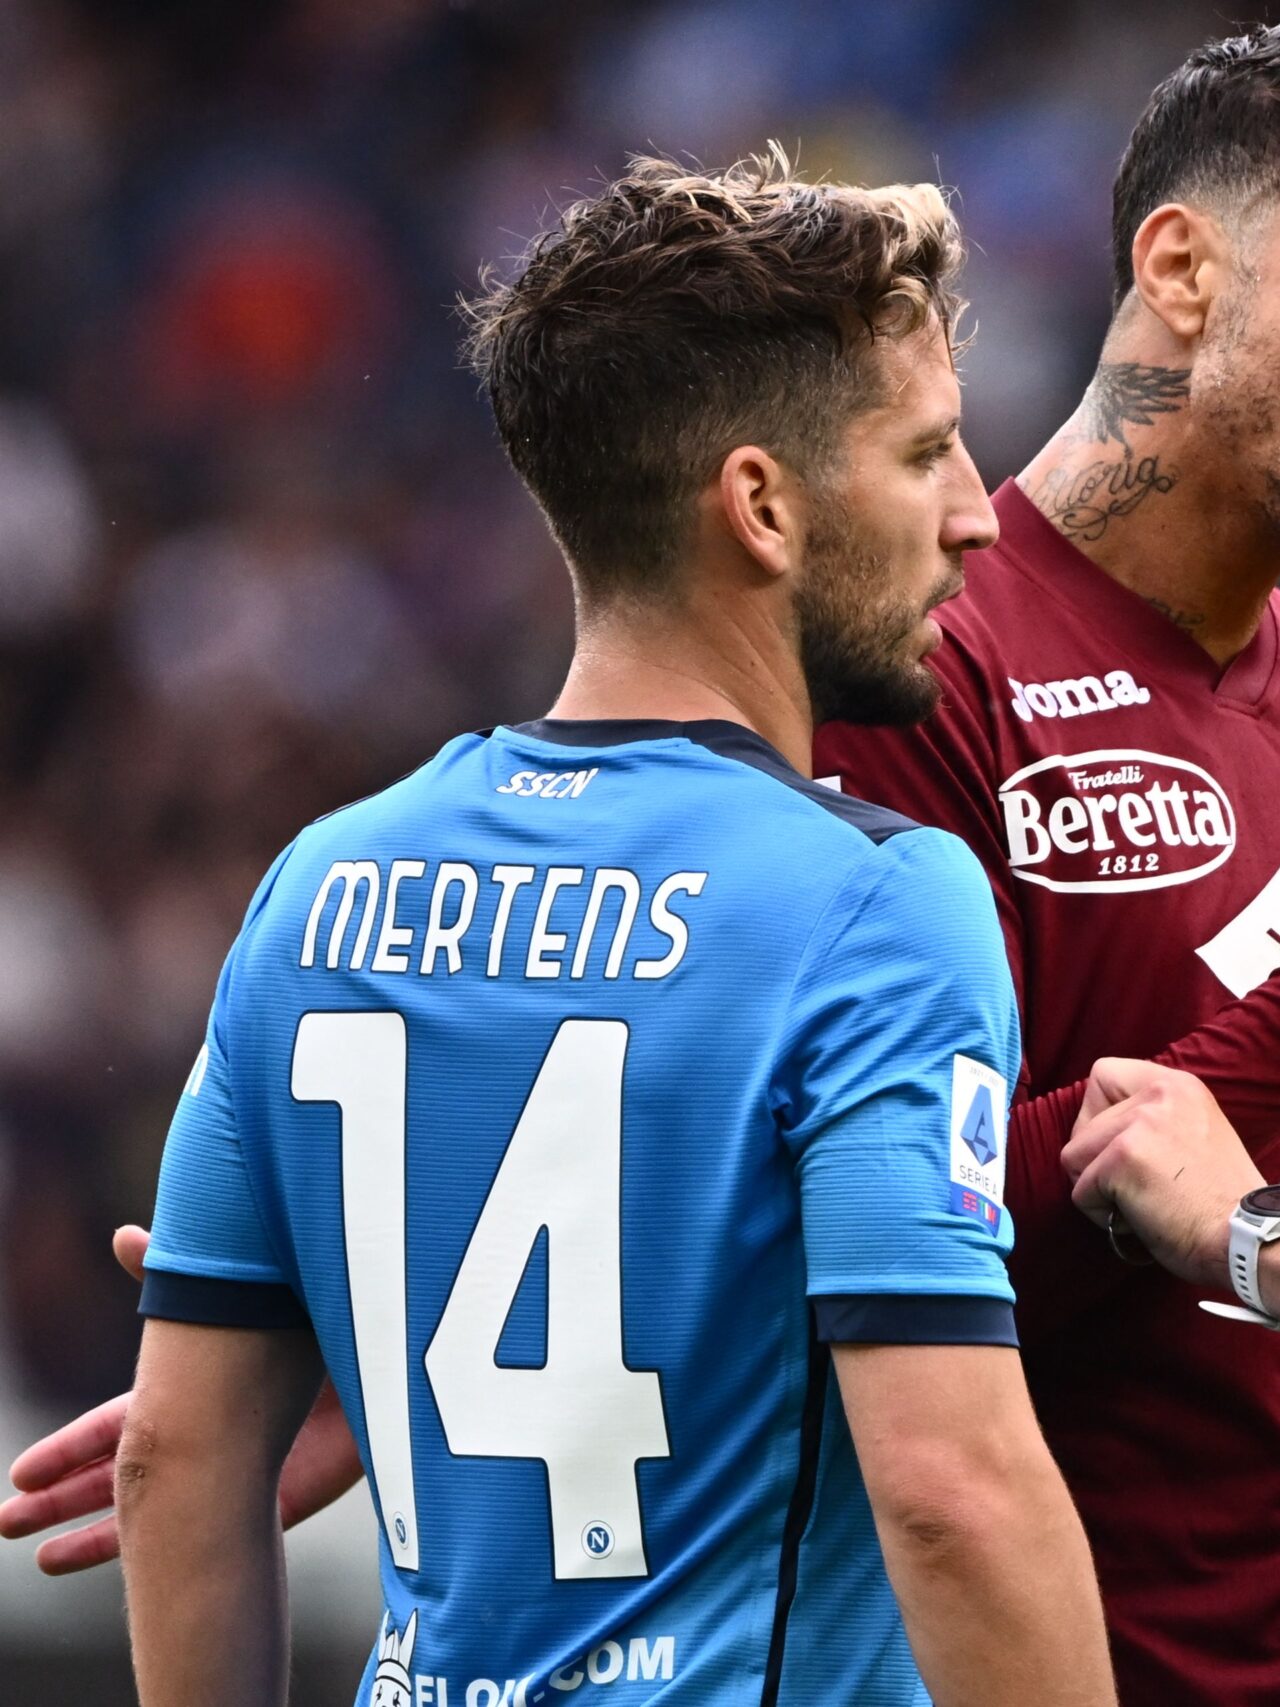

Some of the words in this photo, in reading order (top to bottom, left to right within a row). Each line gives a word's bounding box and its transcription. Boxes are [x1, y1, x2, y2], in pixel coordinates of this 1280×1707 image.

[1007, 670, 1151, 722] Joma
[495, 767, 600, 798] SSCN
[1068, 766, 1145, 790] Fratelli
[998, 780, 1233, 867] Beretta
[1097, 853, 1160, 875] 1812
[300, 859, 709, 979] MERTENS
[959, 1164, 991, 1193] SERIE
[290, 1011, 672, 1582] 14
